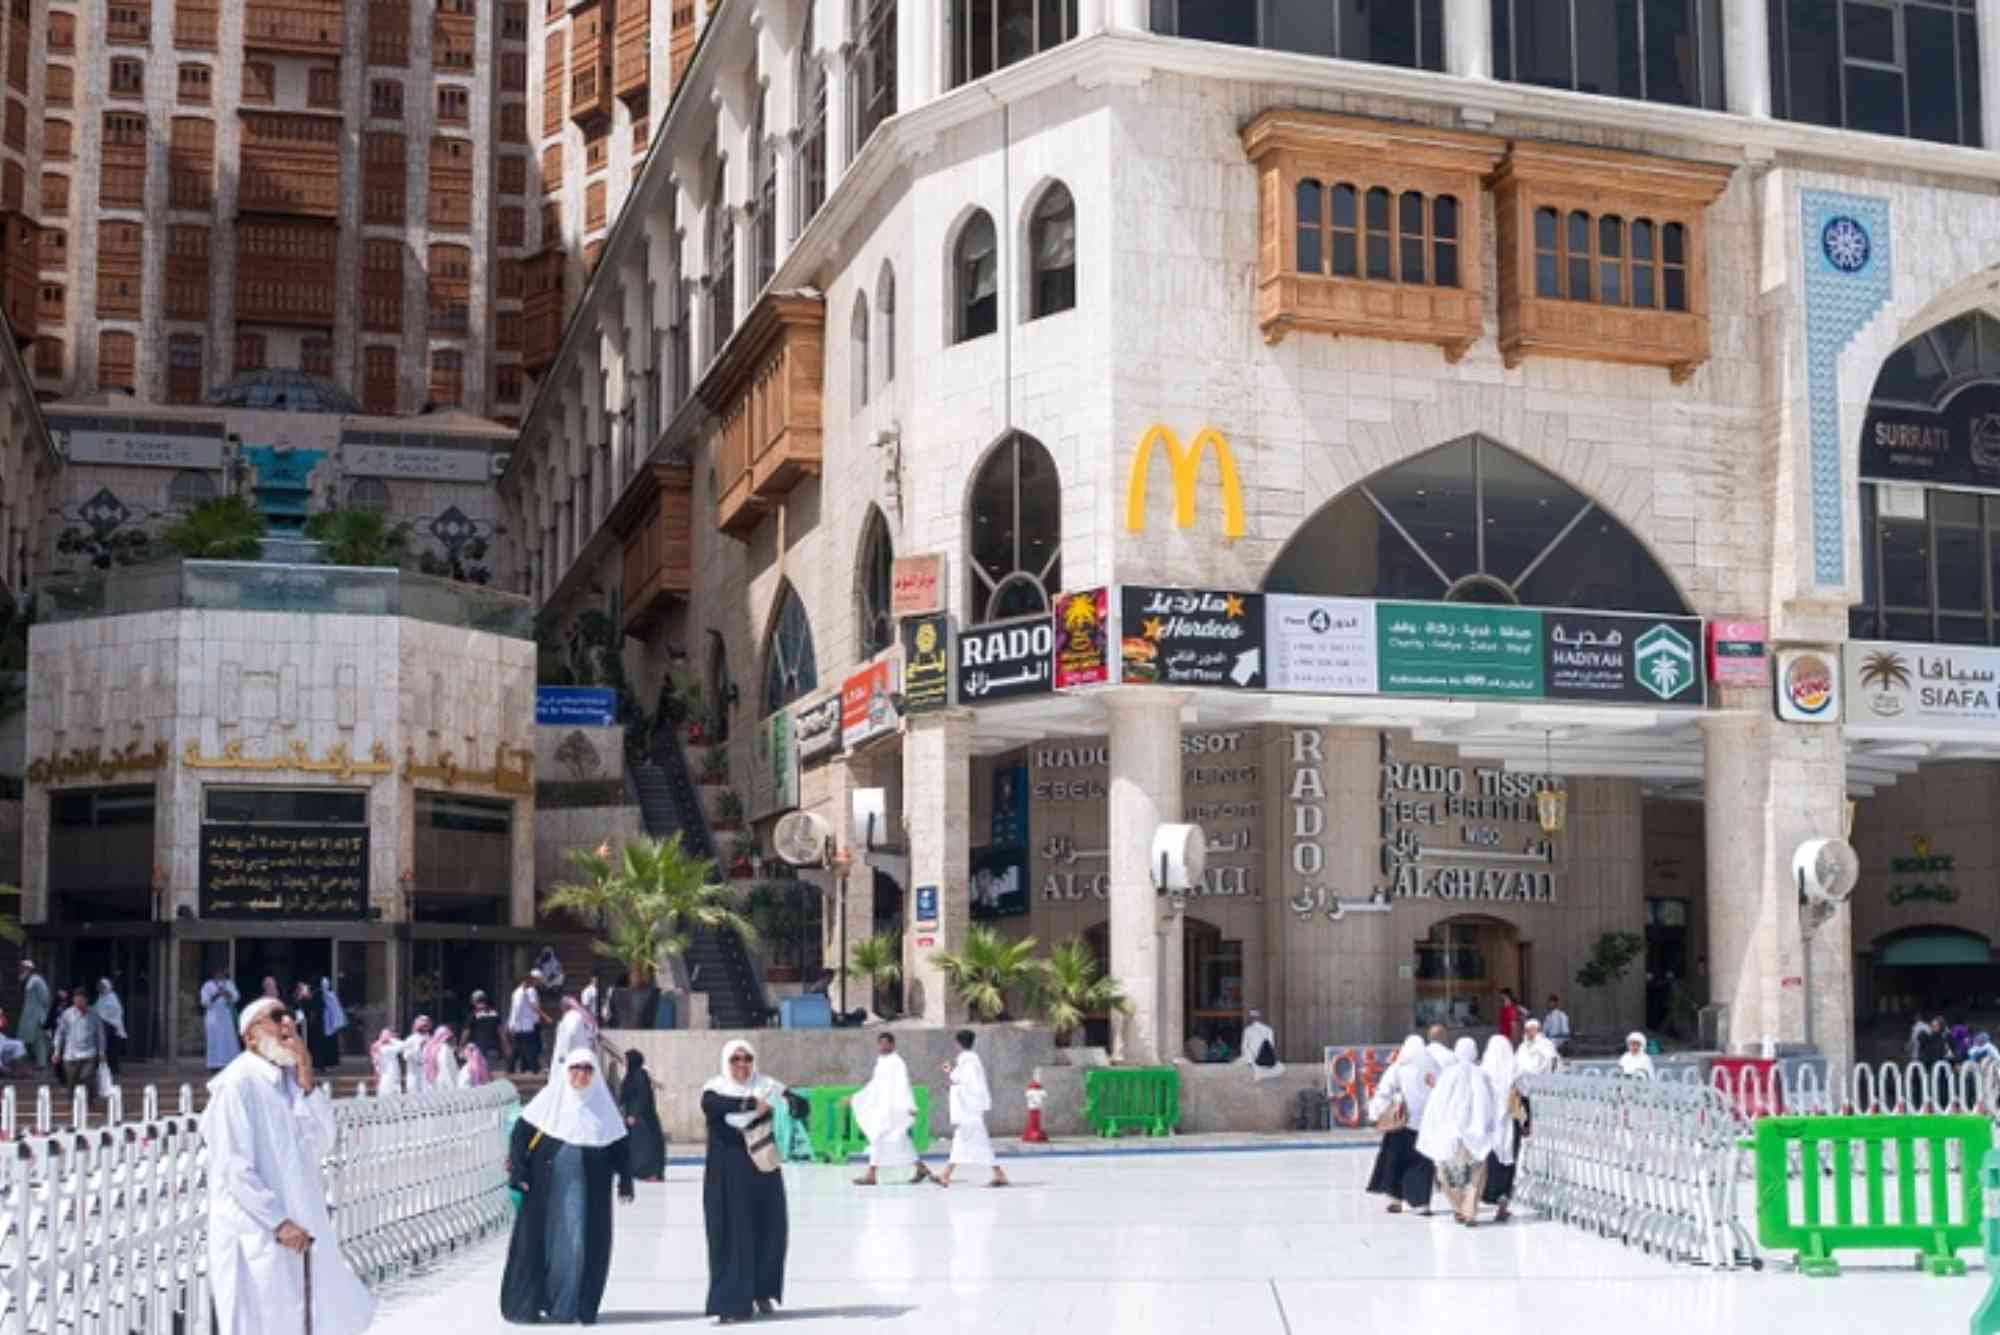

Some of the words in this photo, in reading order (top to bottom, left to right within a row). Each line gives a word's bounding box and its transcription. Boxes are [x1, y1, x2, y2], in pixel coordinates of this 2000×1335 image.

[1875, 422, 1950, 449] SURRATI
[962, 625, 1052, 667] RADO
[1553, 651, 1623, 667] HADIYAH
[1920, 687, 1989, 708] SIAFA
[1386, 763, 1465, 794] RADO
[1290, 730, 1325, 876] RADO
